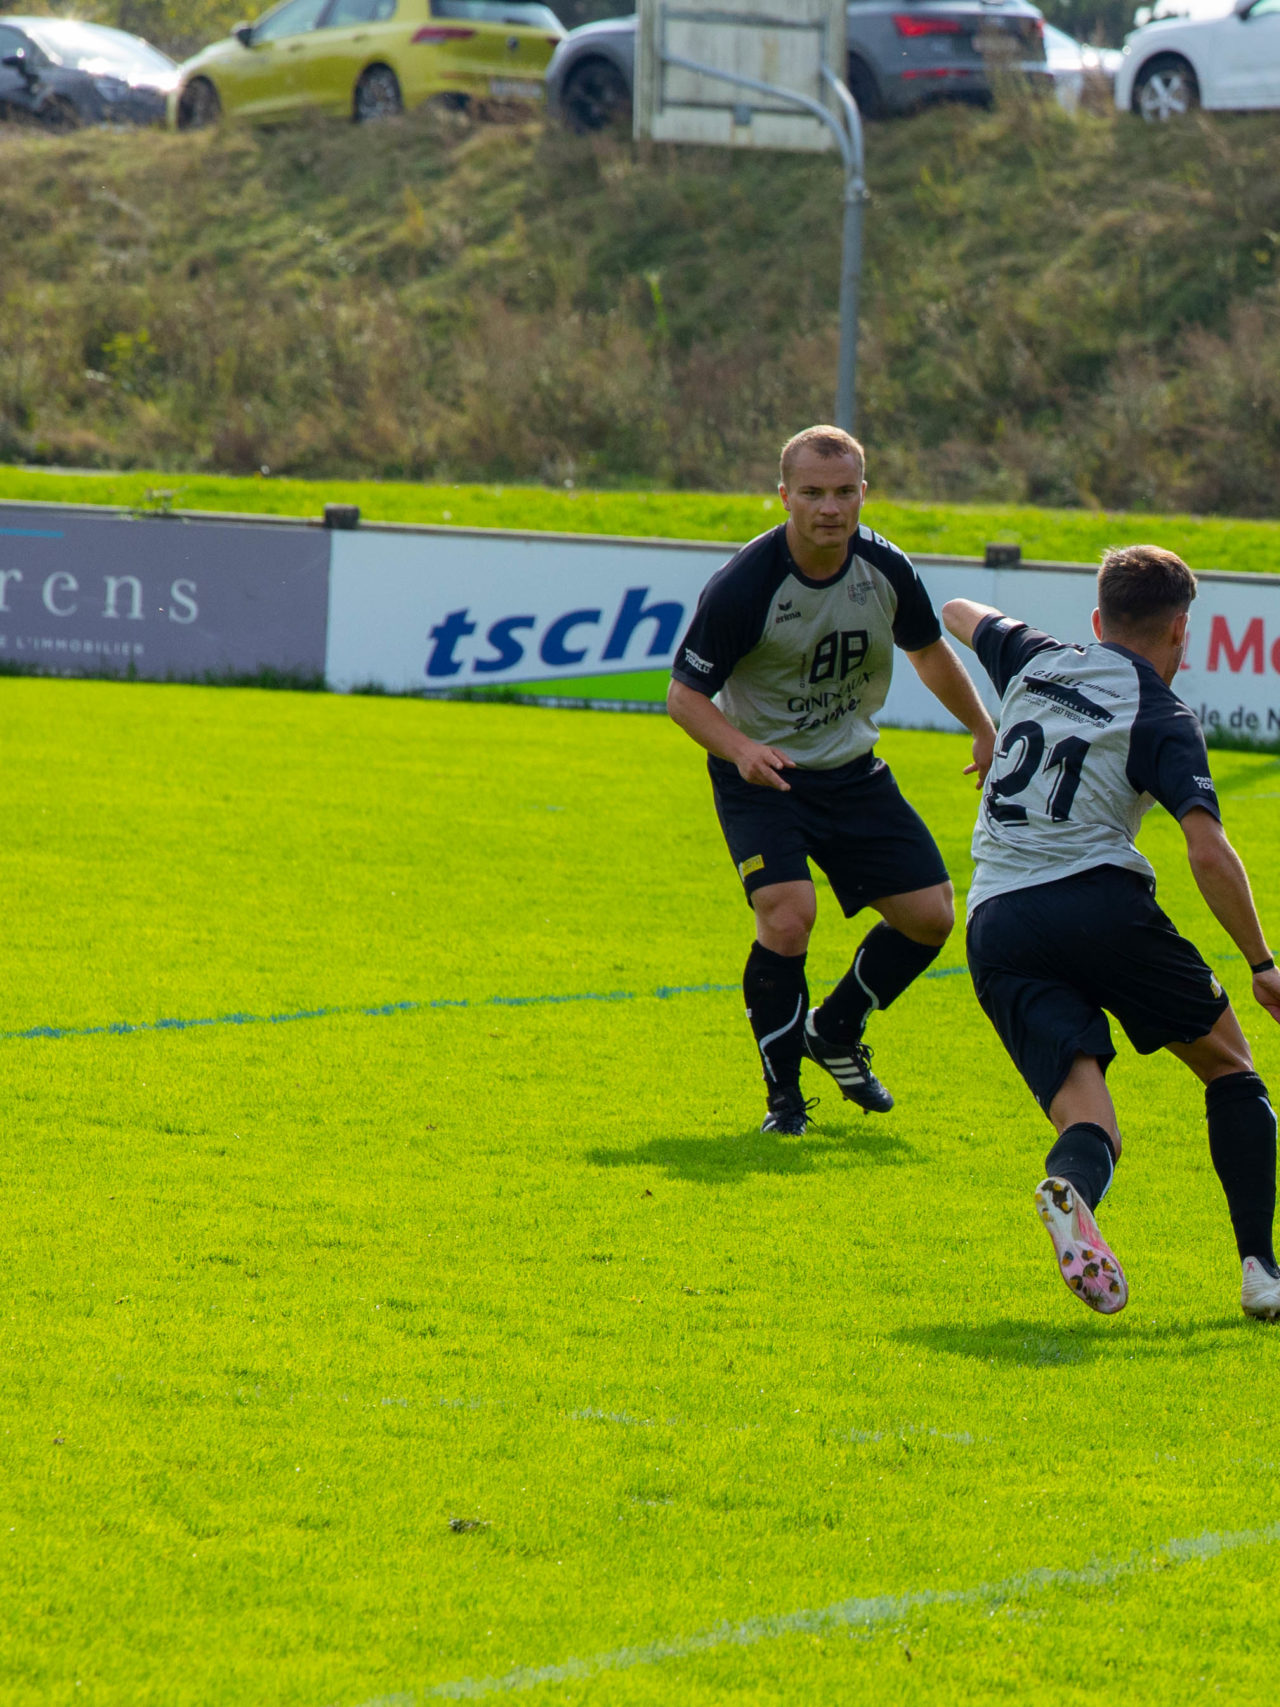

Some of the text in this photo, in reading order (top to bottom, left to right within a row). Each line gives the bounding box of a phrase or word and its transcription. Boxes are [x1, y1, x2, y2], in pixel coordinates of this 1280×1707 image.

[425, 585, 685, 677] tsch
[1230, 705, 1259, 730] de
[984, 719, 1092, 828] 21
